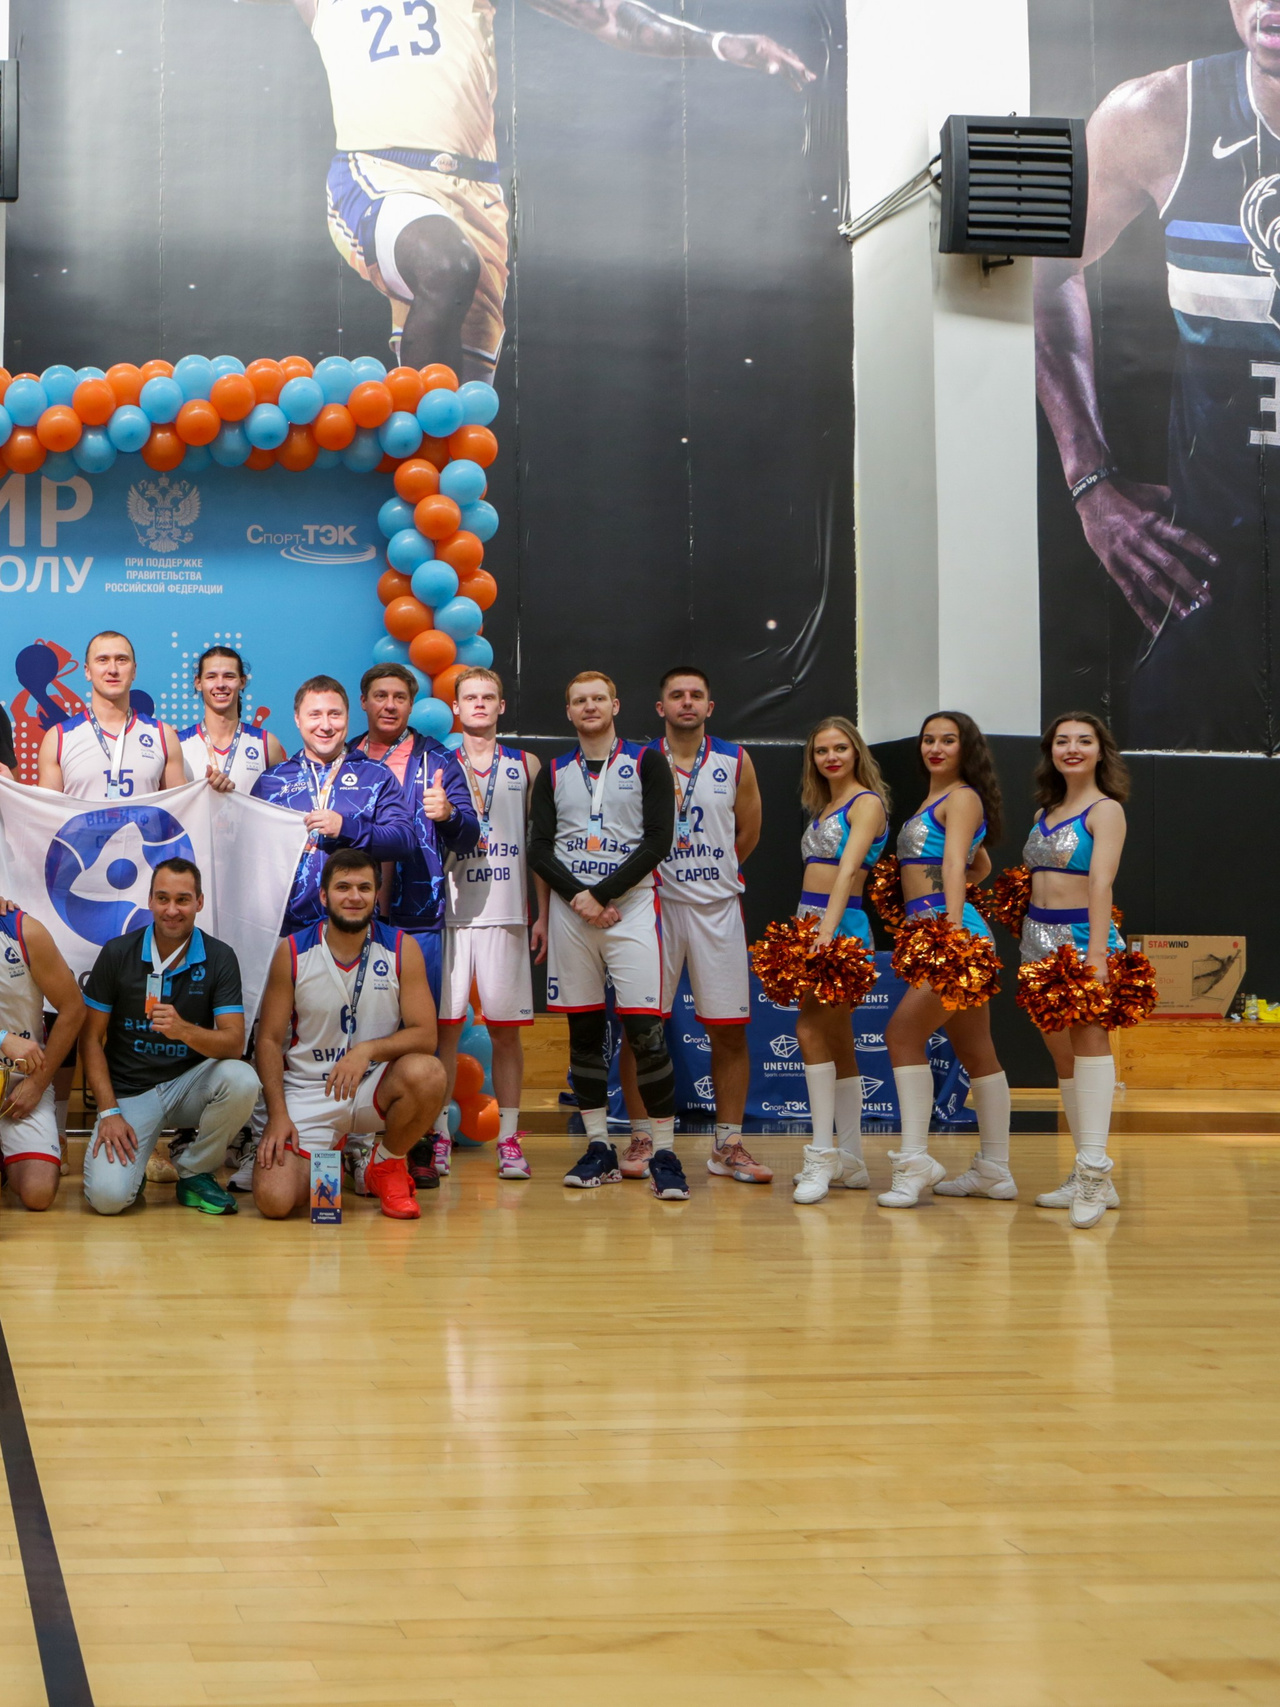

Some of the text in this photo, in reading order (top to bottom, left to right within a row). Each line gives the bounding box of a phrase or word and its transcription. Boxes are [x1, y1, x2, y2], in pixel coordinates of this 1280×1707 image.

[361, 0, 441, 63] 23
[125, 557, 203, 568] ПРИ ПОДДЕРЖКЕ
[126, 570, 202, 581] ПРАВИТЕЛЬСТВА
[105, 582, 223, 595] РОССИЙСКОЙ ФЕДЕРАЦИИ
[689, 806, 704, 833] 2
[466, 867, 510, 882] САРОВ
[571, 860, 618, 876] САРОВ
[676, 867, 719, 882] САРОВ
[1148, 940, 1189, 948] STARWIND
[547, 977, 559, 1000] 5
[341, 1004, 357, 1034] 6
[134, 1039, 188, 1057] САРОВ
[763, 1062, 806, 1071] UNEVENT
